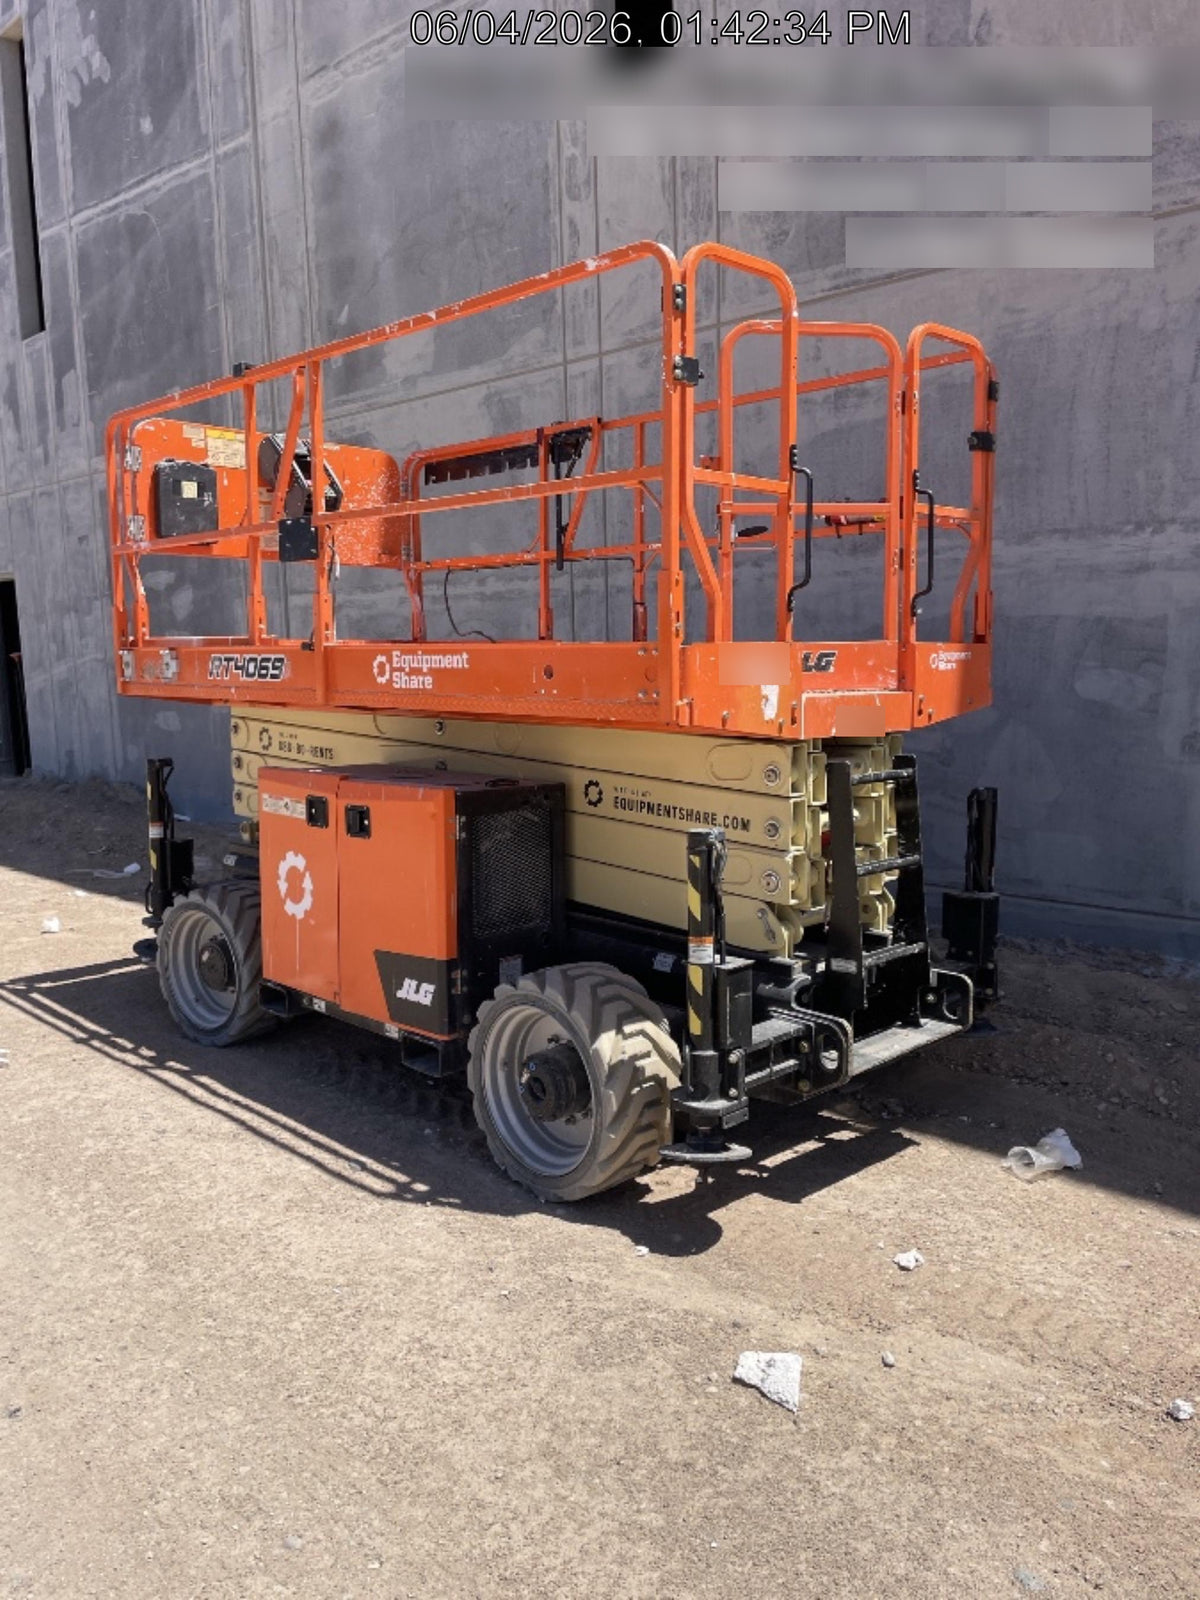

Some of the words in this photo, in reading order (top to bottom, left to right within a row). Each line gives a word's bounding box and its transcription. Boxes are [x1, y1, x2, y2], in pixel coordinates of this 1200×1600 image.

[208, 654, 286, 681] RT4069
[392, 650, 469, 672] Equipment
[392, 671, 433, 689] Share
[613, 795, 751, 832] EQUIPMENTSHARE.COM
[396, 977, 436, 1007] JLG
